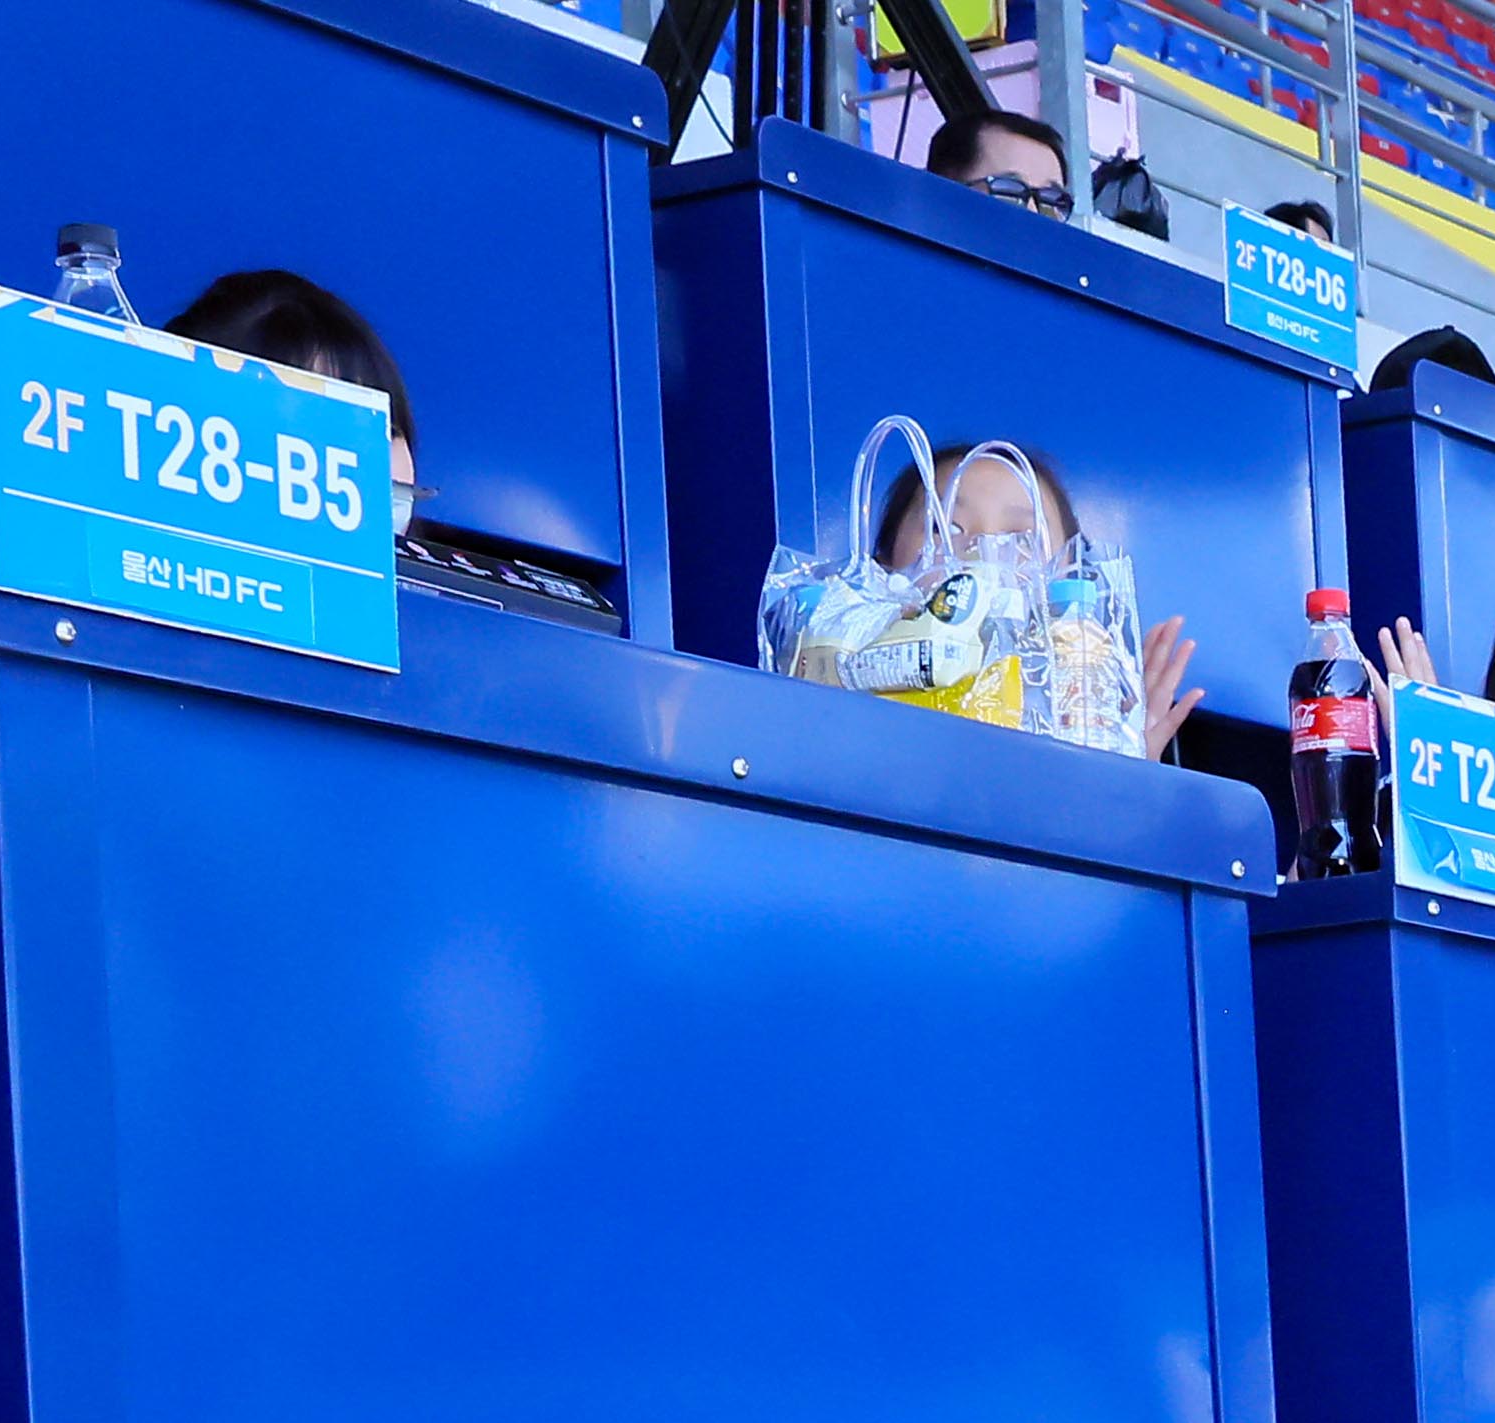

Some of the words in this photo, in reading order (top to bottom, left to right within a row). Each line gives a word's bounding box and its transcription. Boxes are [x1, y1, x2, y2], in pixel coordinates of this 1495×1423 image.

[1236, 240, 1256, 270] 2F
[1261, 245, 1346, 311] T28-D6
[1303, 327, 1320, 343] FC
[21, 381, 84, 453] 2F
[106, 390, 362, 531] T28-B5
[121, 550, 171, 589] 울산
[178, 561, 230, 598] HD
[236, 580, 284, 612] FC
[1410, 738, 1442, 787] 2F
